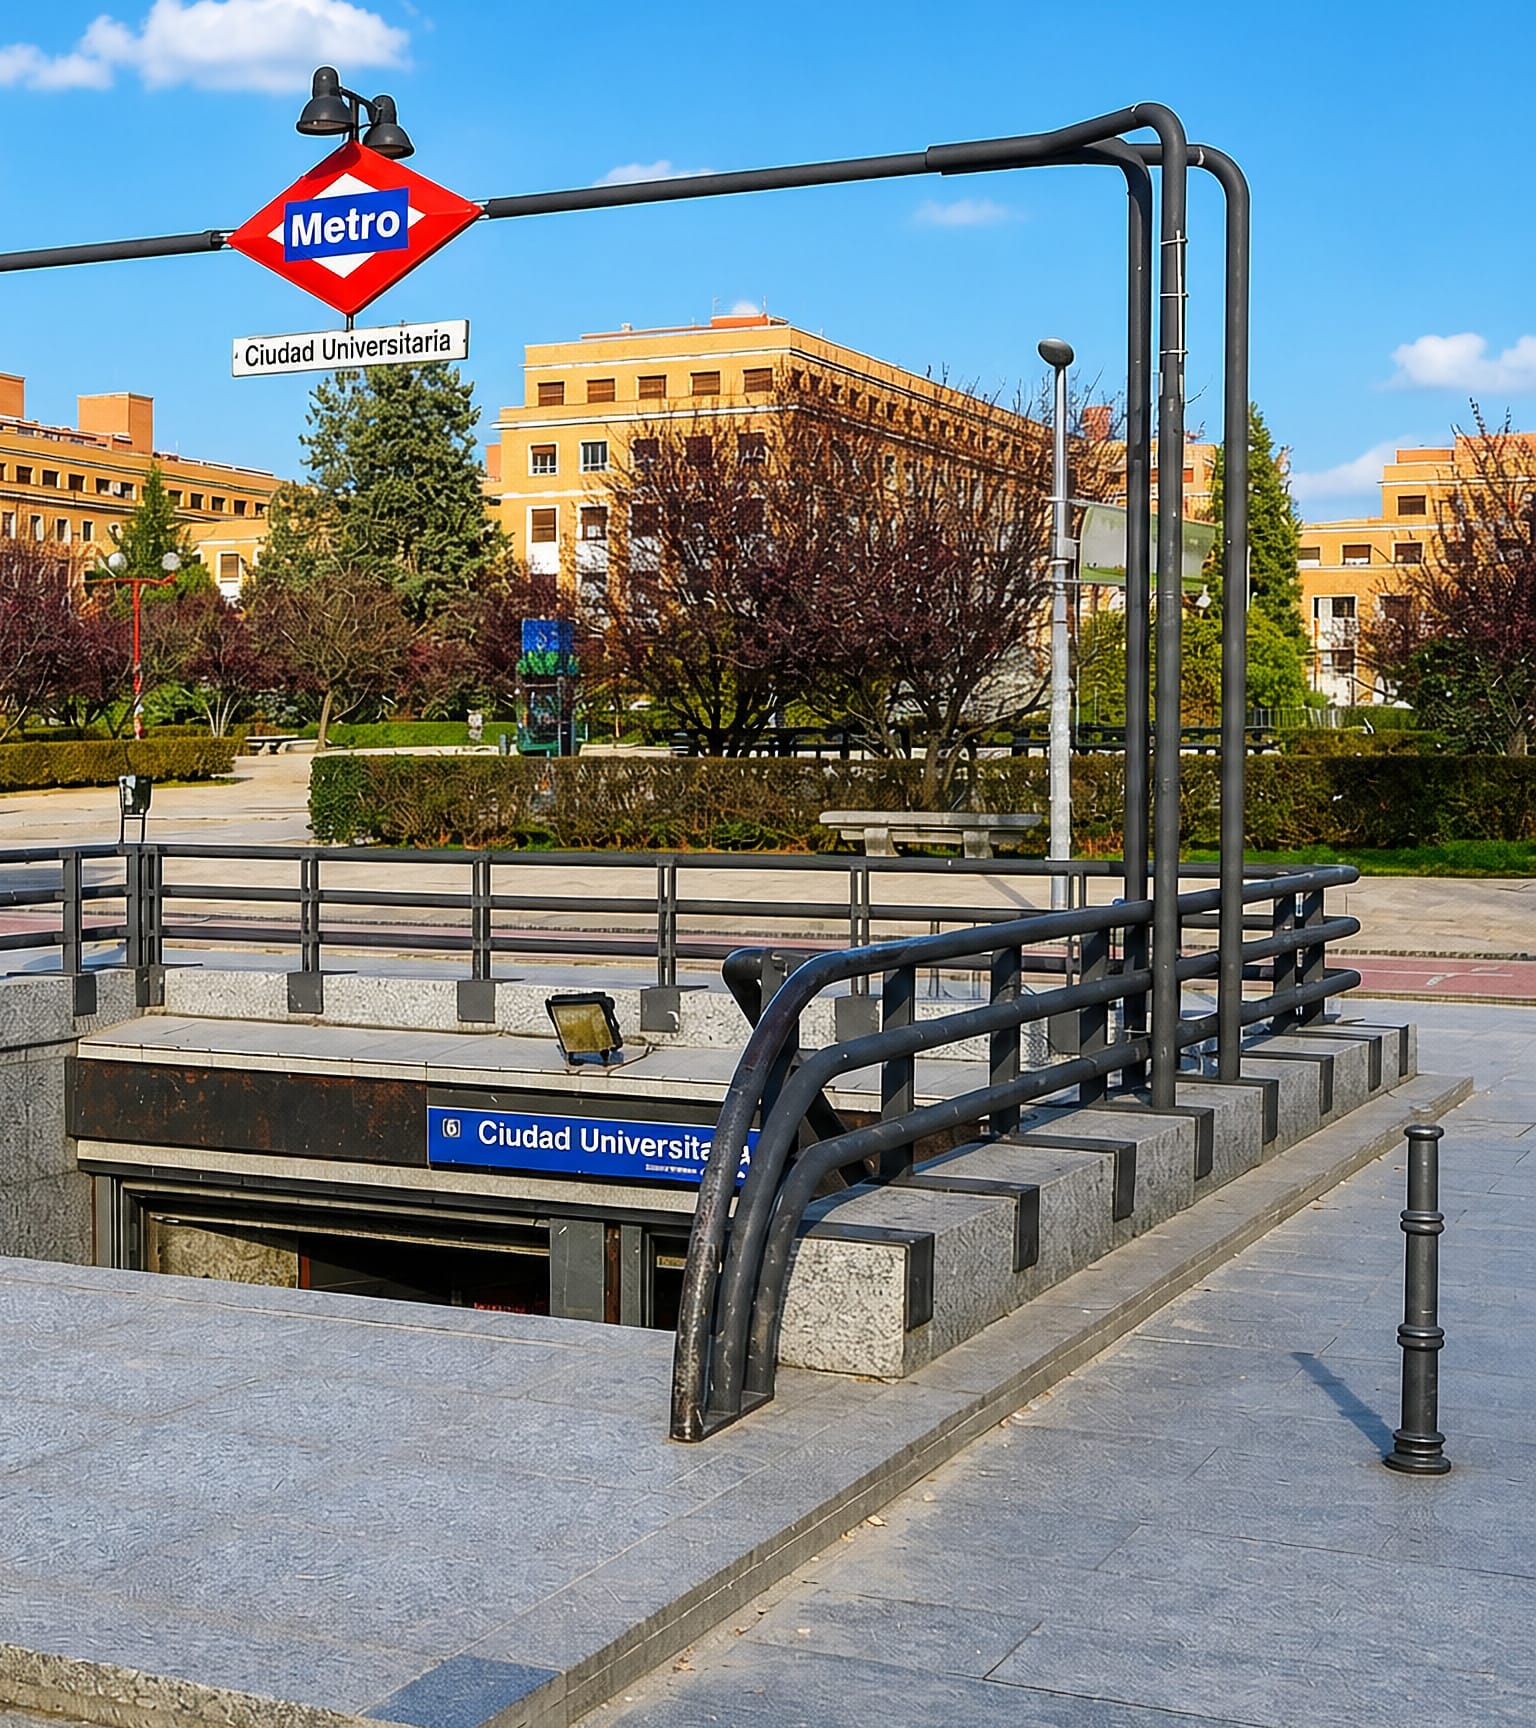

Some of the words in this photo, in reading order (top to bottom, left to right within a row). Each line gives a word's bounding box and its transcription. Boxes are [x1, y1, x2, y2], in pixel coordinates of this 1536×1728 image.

[291, 207, 401, 248] Metro
[245, 340, 315, 367] Ciudad
[322, 329, 452, 360] Universitaria
[478, 1120, 571, 1151] Ciudad
